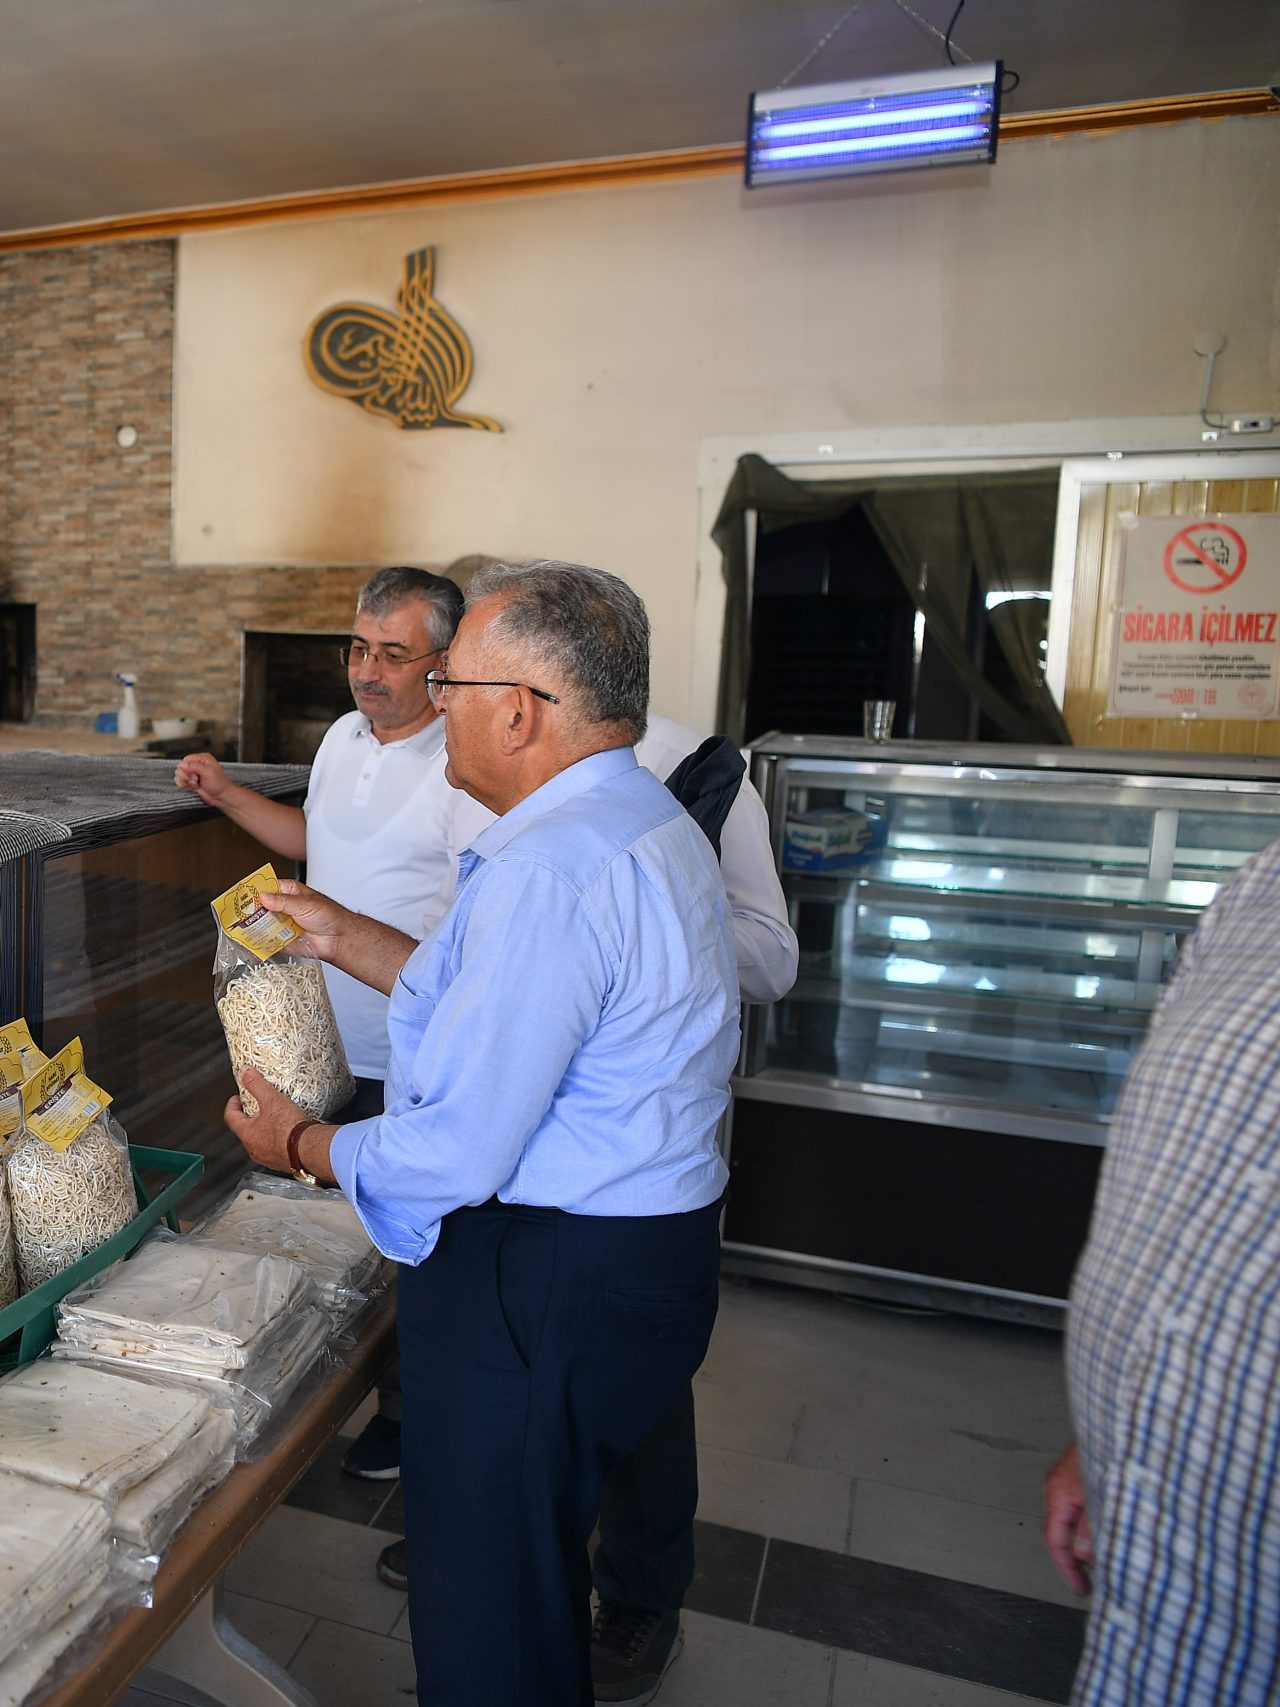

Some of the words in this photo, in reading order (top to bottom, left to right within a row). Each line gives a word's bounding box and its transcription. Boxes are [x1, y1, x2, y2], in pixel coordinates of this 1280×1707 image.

[1123, 604, 1194, 643] SİGARA
[1199, 604, 1277, 647] İÇİLMEZ
[44, 1088, 66, 1110] ERİŞTE
